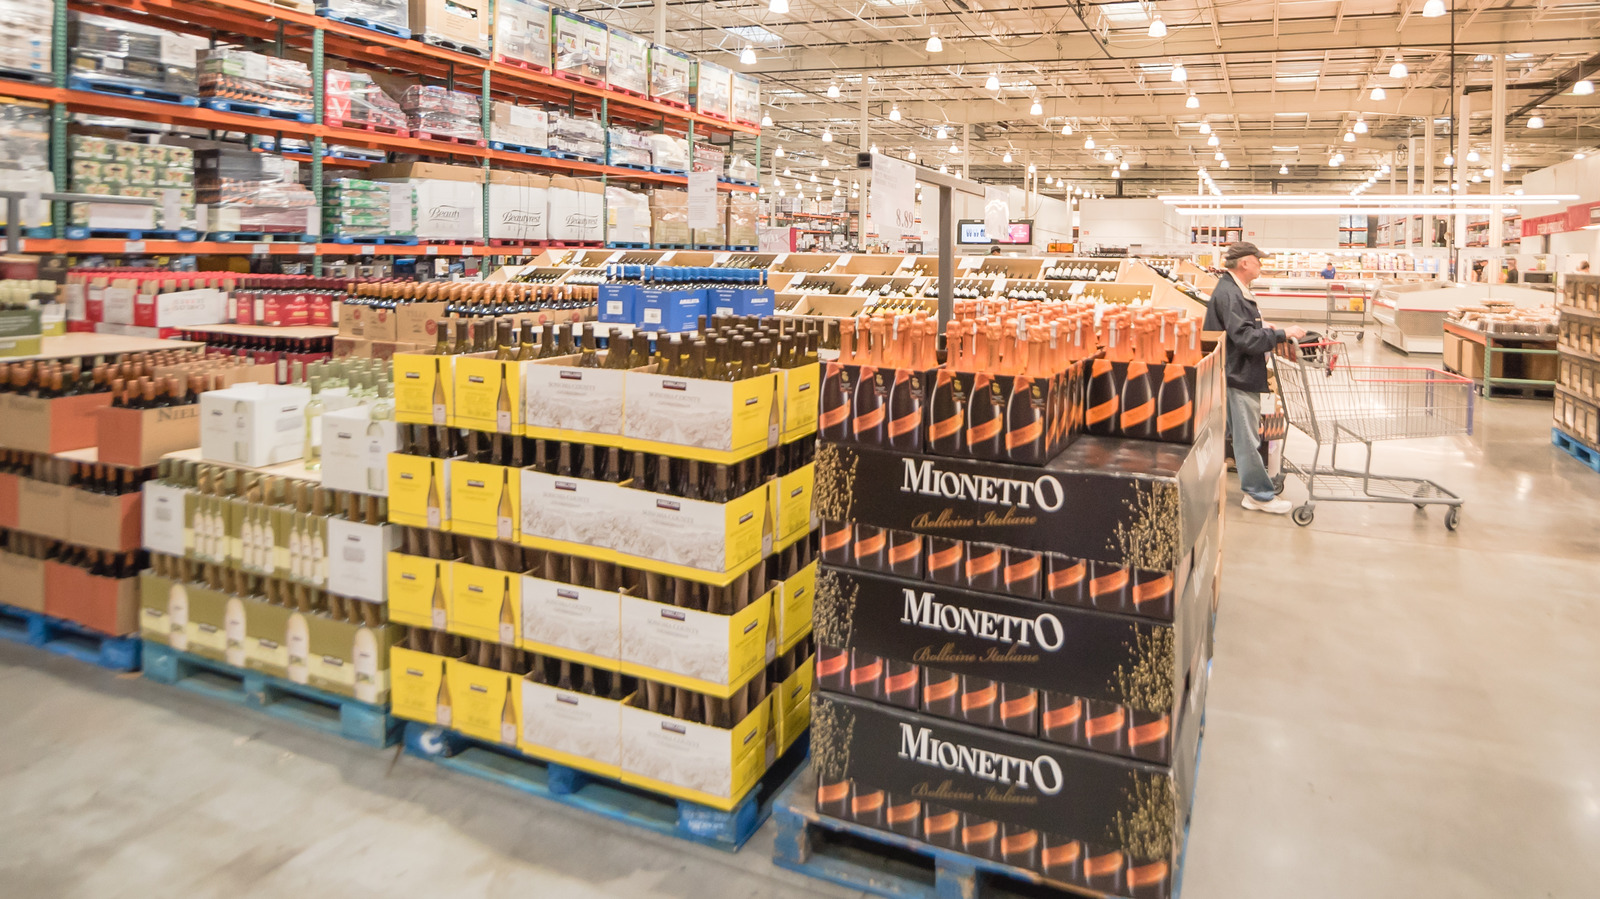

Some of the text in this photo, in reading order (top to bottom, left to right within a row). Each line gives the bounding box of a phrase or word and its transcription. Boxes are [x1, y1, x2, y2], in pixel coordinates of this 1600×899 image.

[428, 206, 460, 220] Beauty
[502, 211, 541, 224] Beautyrest
[566, 214, 598, 226] Beautyrest
[896, 208, 914, 229] 8.89
[156, 407, 199, 423] NIEL
[900, 457, 1064, 513] MIONETTO
[911, 505, 1038, 529] Bollicine Italiane
[900, 588, 1064, 652] MIONETTO
[912, 641, 1040, 663] Bollicine Italiane
[898, 722, 1064, 796] MIONETTO
[911, 779, 1038, 805] Bollicine Italiane
